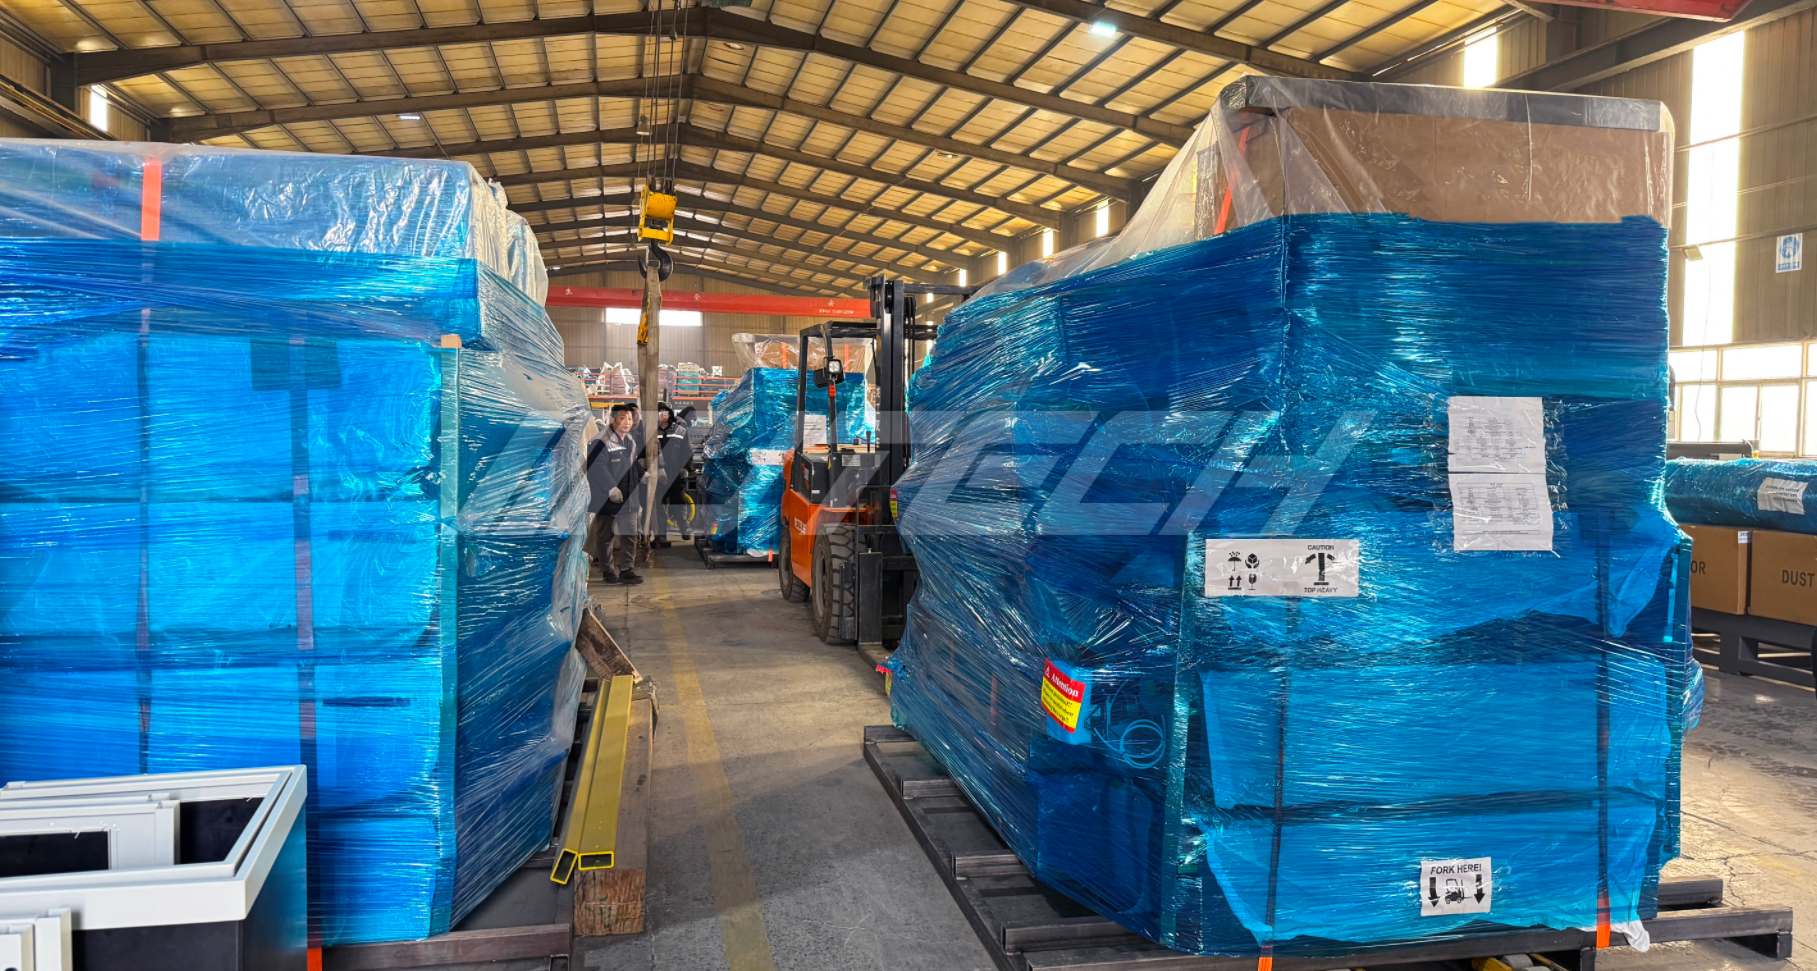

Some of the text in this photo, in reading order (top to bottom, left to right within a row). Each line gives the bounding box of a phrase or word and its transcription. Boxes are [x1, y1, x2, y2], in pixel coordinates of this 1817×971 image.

[1691, 560, 1706, 575] OR
[1782, 569, 1816, 588] DUST
[1052, 673, 1079, 697] Attention
[1430, 863, 1482, 875] FORK HERE!
